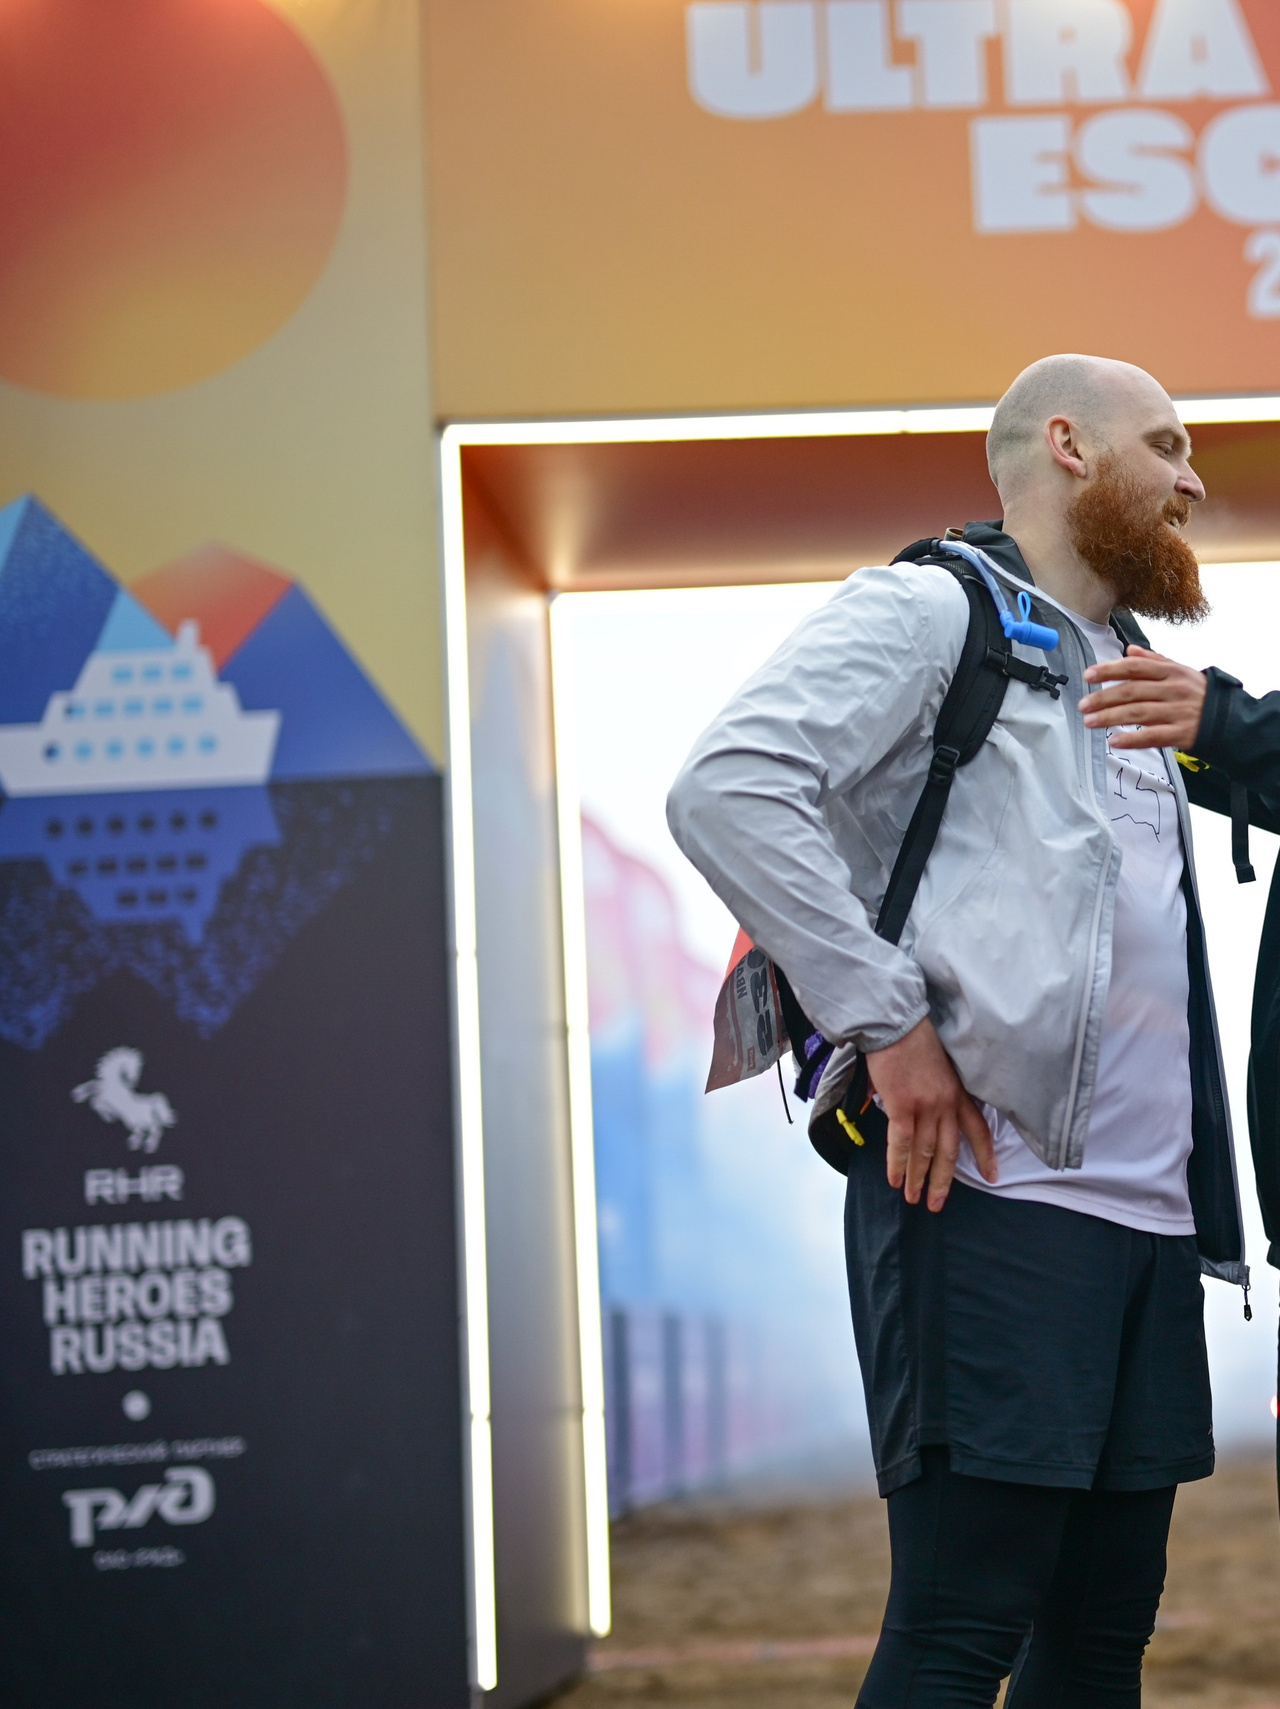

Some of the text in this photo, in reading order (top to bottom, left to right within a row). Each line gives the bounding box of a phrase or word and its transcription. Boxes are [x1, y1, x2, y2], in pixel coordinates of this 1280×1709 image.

[685, 0, 1271, 119] ULTRA
[84, 1164, 184, 1205] RHR
[22, 1215, 252, 1280] RUNNING
[43, 1265, 234, 1327] HEROES
[50, 1317, 231, 1376] RUSSIA
